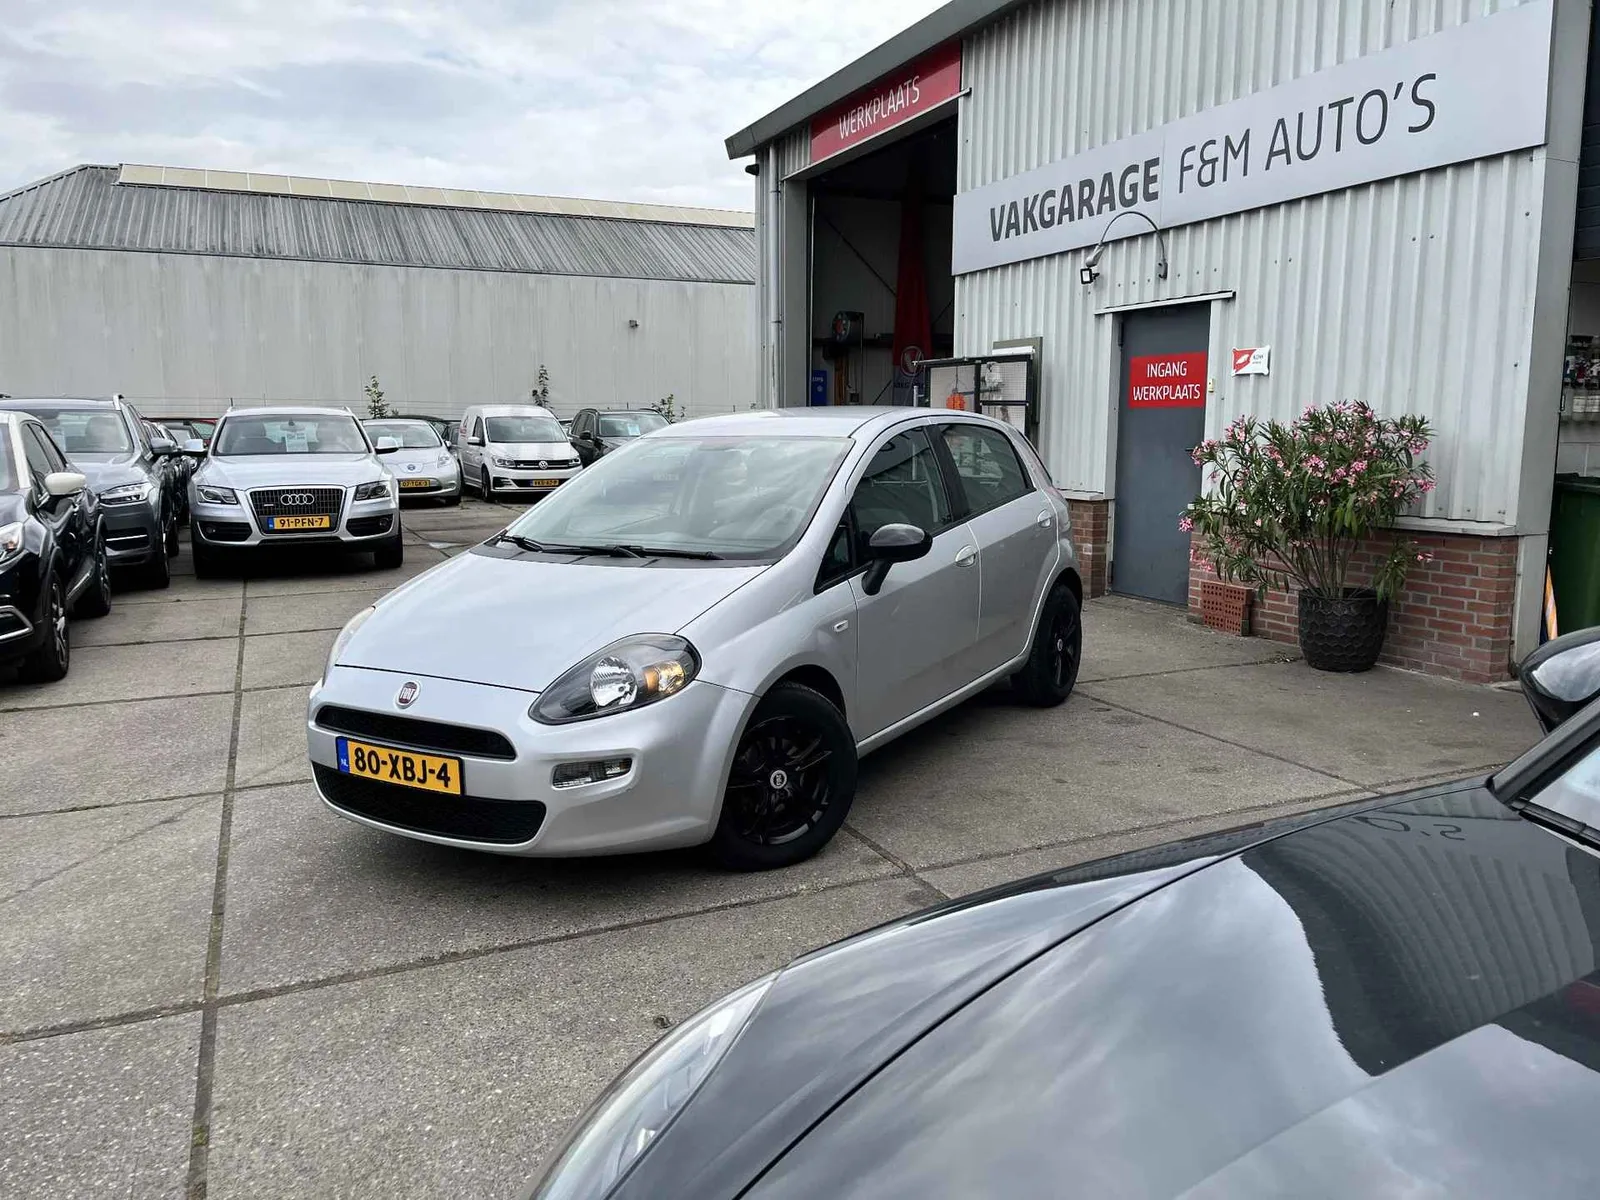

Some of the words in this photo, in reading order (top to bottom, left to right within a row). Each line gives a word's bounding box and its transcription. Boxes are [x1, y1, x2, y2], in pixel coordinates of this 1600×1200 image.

[839, 75, 920, 140] WERKPLAATS
[990, 156, 1160, 243] VAKGARAGE
[1178, 128, 1250, 194] F&M
[1264, 73, 1437, 173] AUTO'S
[1146, 360, 1187, 378] INGANG
[1132, 383, 1201, 401] WERKPLAATS
[279, 517, 324, 528] 91-PFN-7
[353, 746, 451, 788] 80-XBJ-4
